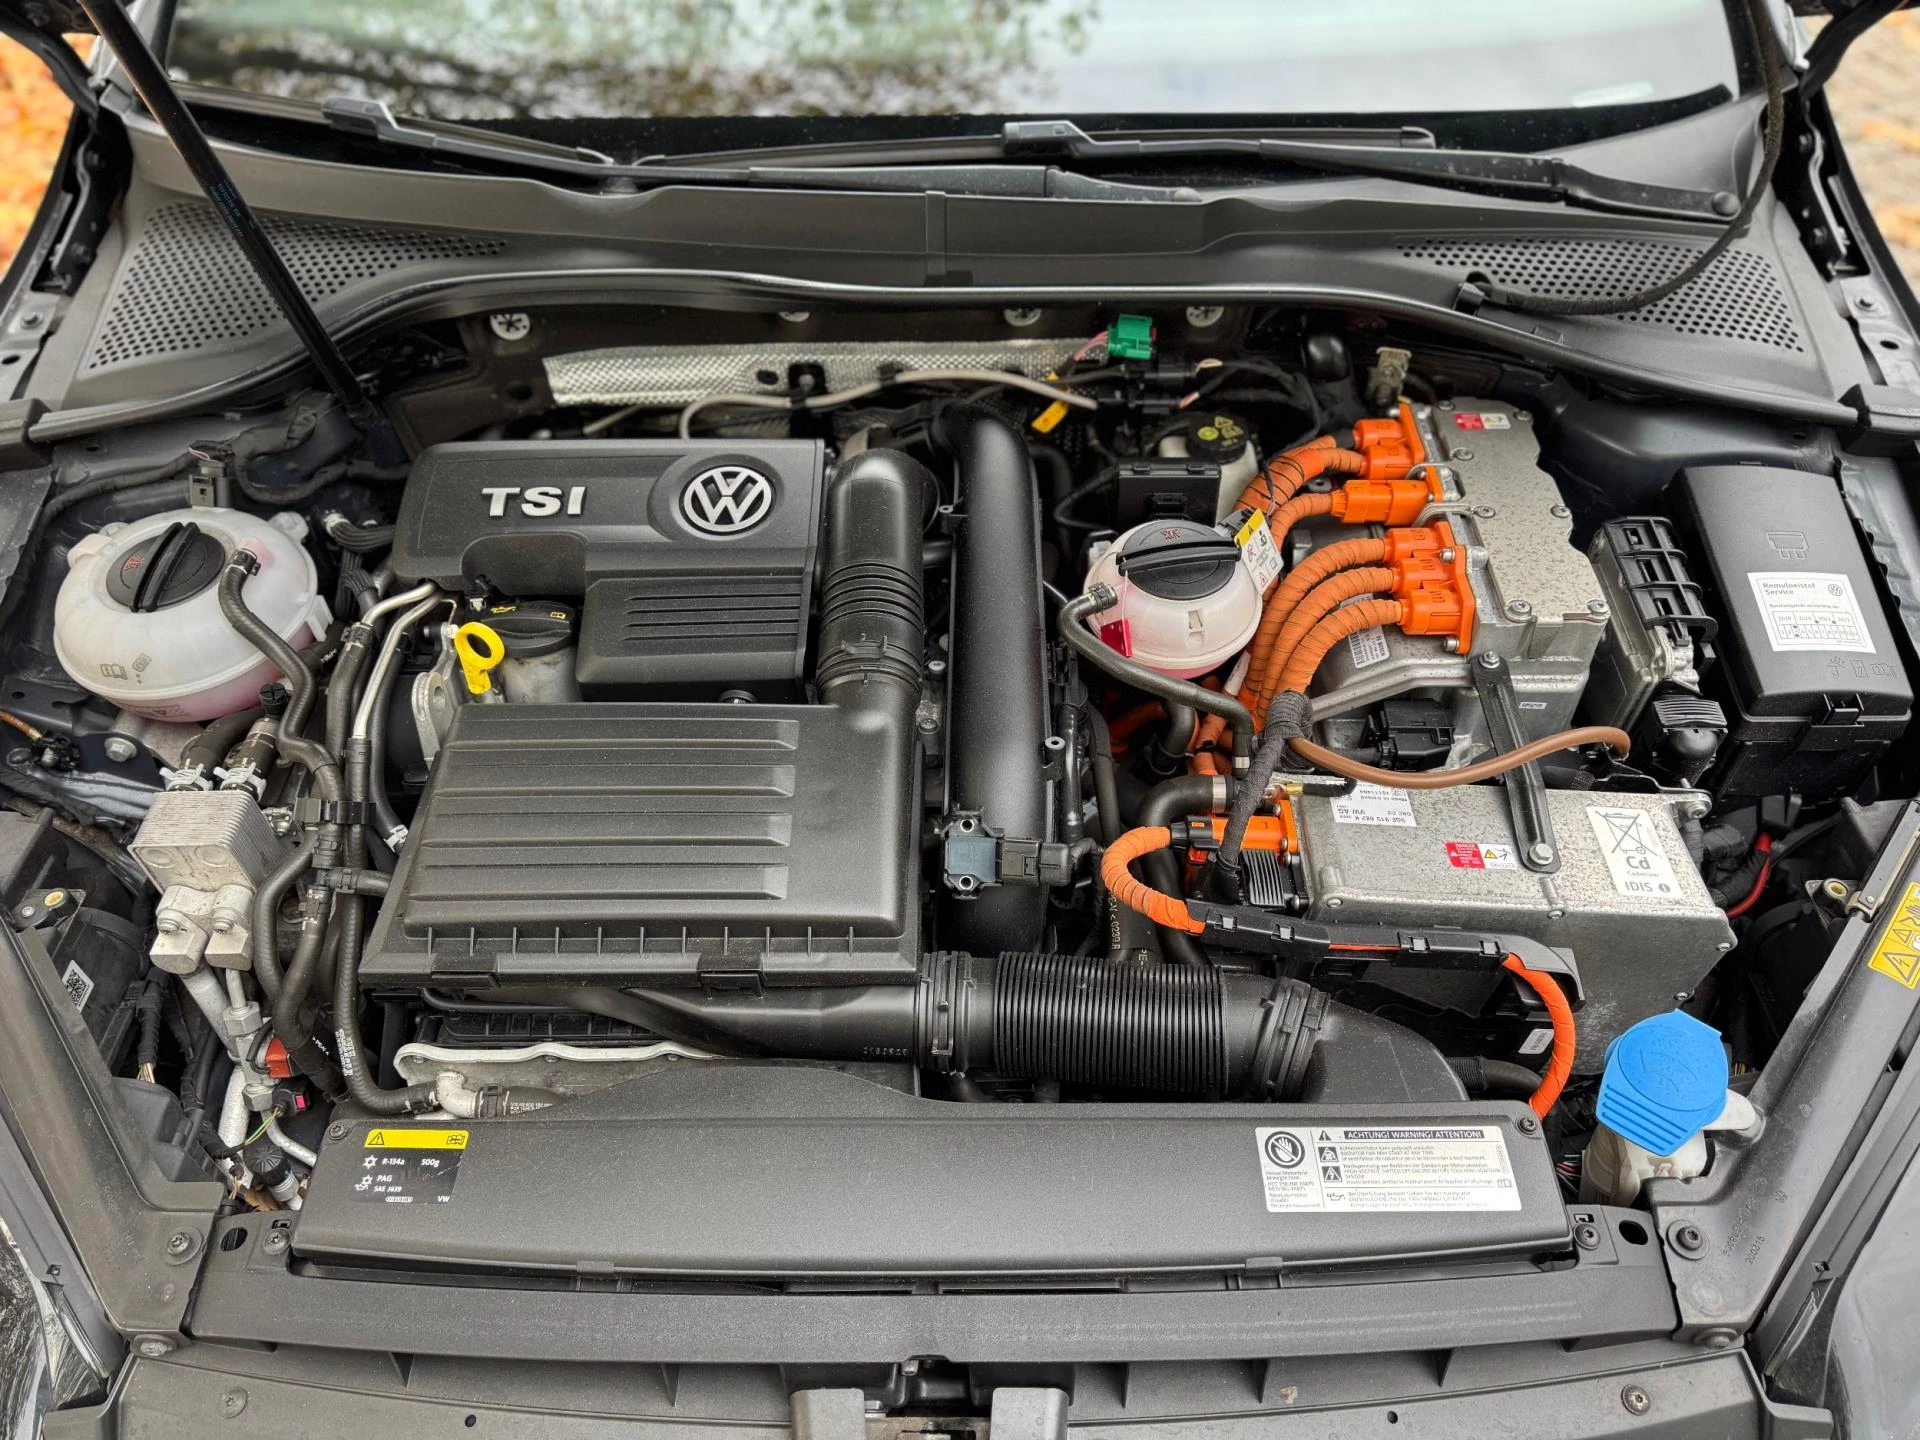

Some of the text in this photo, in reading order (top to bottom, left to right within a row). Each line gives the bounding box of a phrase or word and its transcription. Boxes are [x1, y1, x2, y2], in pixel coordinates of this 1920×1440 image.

[481, 486, 586, 517] TSI
[1626, 856, 1651, 869] Cd
[1627, 870, 1659, 878] Cadmium
[1624, 881, 1653, 892] IDIS
[1347, 1130, 1481, 1139] ACHTUNG! WARNING! ATTENTION!
[421, 1159, 440, 1167] 500g
